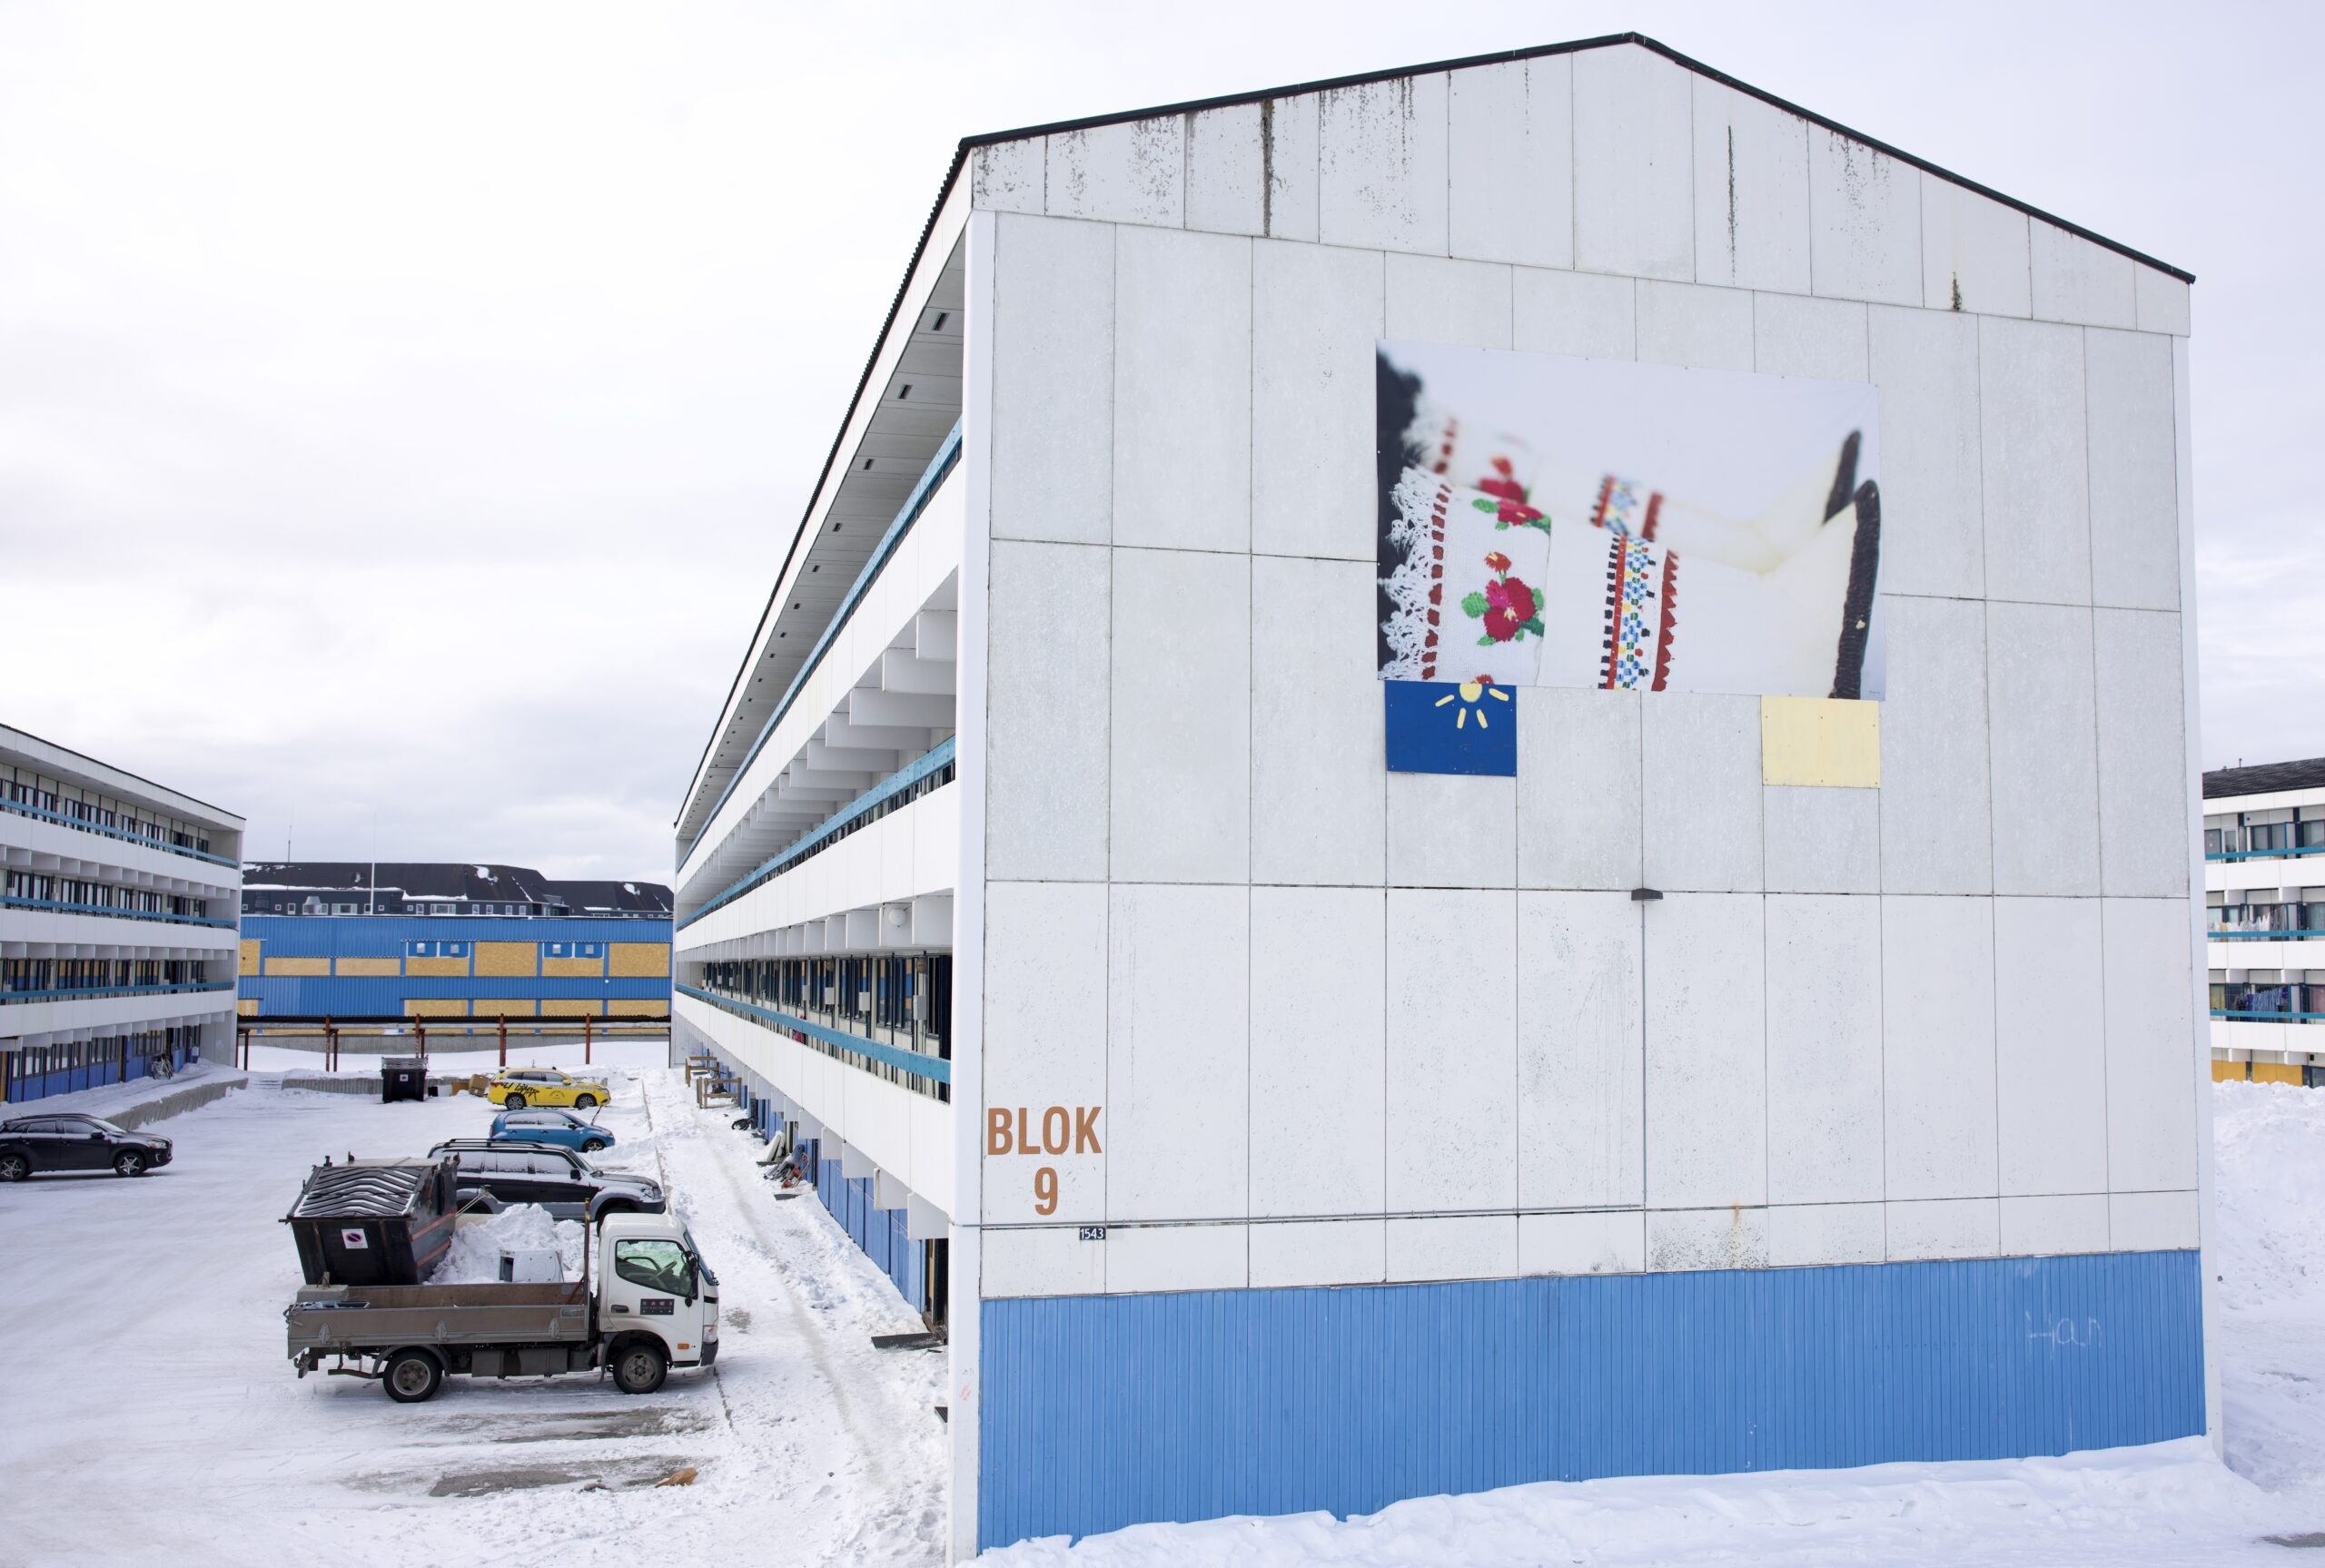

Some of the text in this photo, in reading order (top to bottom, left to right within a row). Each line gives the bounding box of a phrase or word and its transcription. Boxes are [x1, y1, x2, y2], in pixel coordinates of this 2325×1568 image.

[987, 1106, 1103, 1156] BLOK
[1034, 1166, 1059, 1217] 9
[1080, 1228, 1104, 1239] 1543
